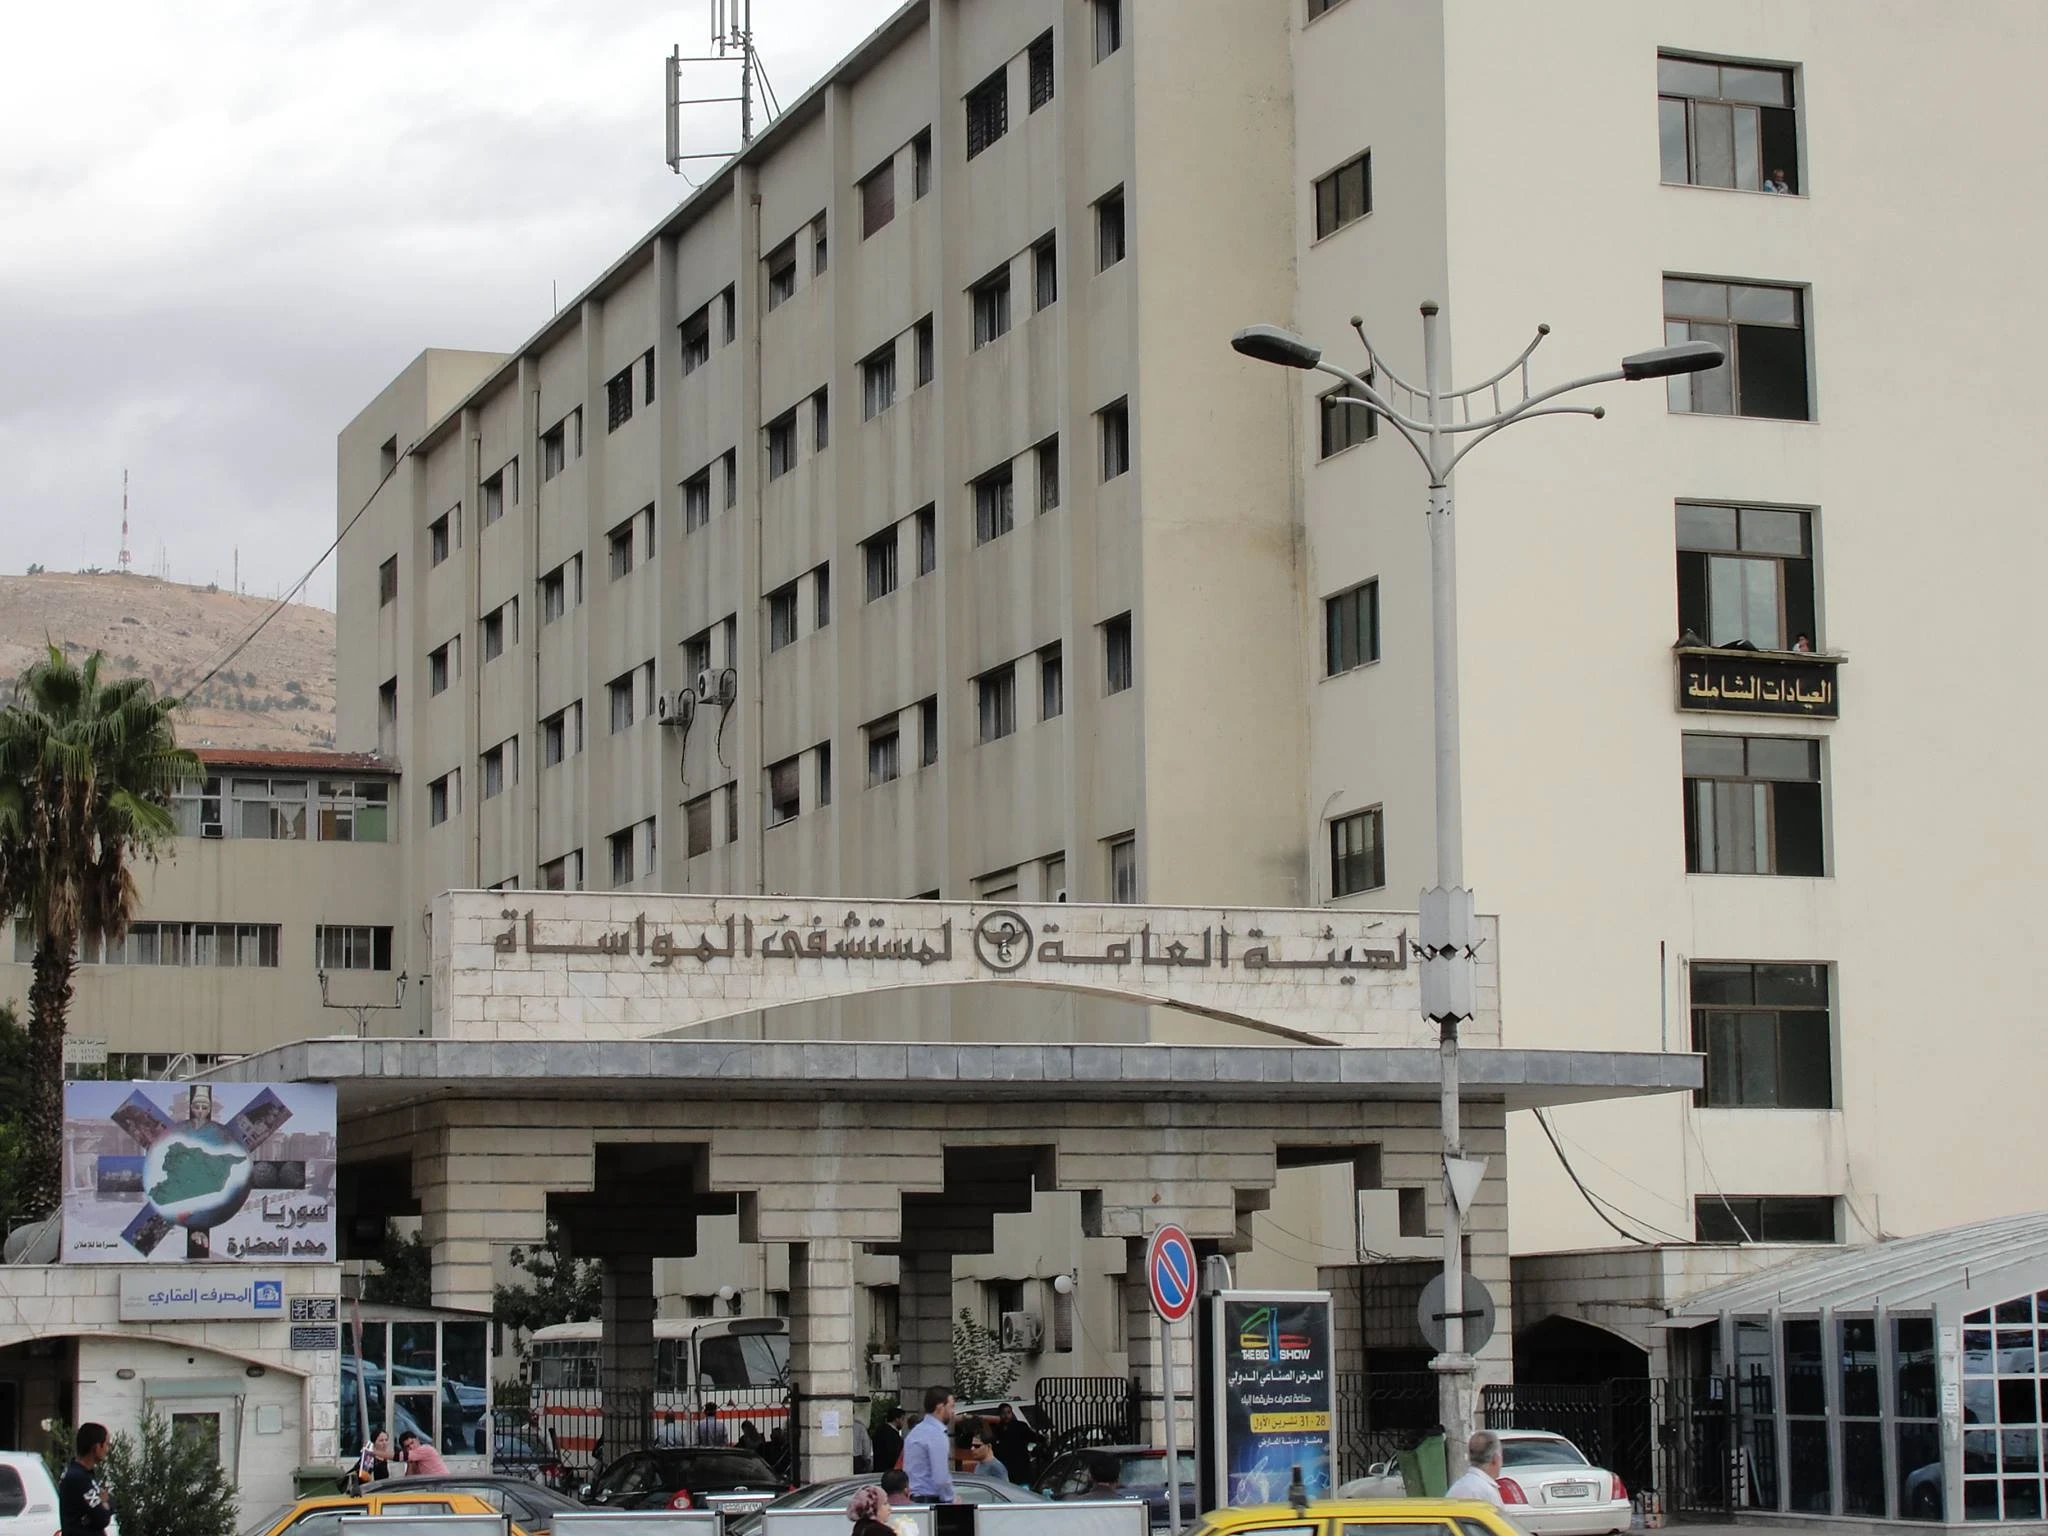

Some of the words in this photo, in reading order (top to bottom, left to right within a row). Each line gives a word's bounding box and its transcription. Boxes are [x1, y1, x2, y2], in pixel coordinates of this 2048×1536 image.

[1688, 673, 1761, 702] الشاملة
[1763, 677, 1832, 710] العيادات
[495, 908, 754, 967] المواساة
[761, 910, 953, 966] لمستشفى
[1037, 922, 1230, 969] العامة
[1243, 921, 1408, 986] لهيئة
[261, 1195, 329, 1229] سوريا
[226, 1236, 289, 1259] الحضارة
[292, 1238, 328, 1256] مهد
[148, 1287, 198, 1306] العقاري
[200, 1287, 252, 1304] المصرف
[1241, 1349, 1255, 1361] THE
[1255, 1349, 1269, 1361] BIG
[1279, 1349, 1311, 1361] SHOW
[1228, 1370, 1259, 1388] الدولي
[1259, 1369, 1295, 1387] الصناعي
[1295, 1370, 1324, 1384] المعرض
[1271, 1416, 1298, 1429] تشرين
[1300, 1415, 1309, 1427] 31
[1316, 1415, 1326, 1426] 28
[1303, 1436, 1323, 1446] دمشق
